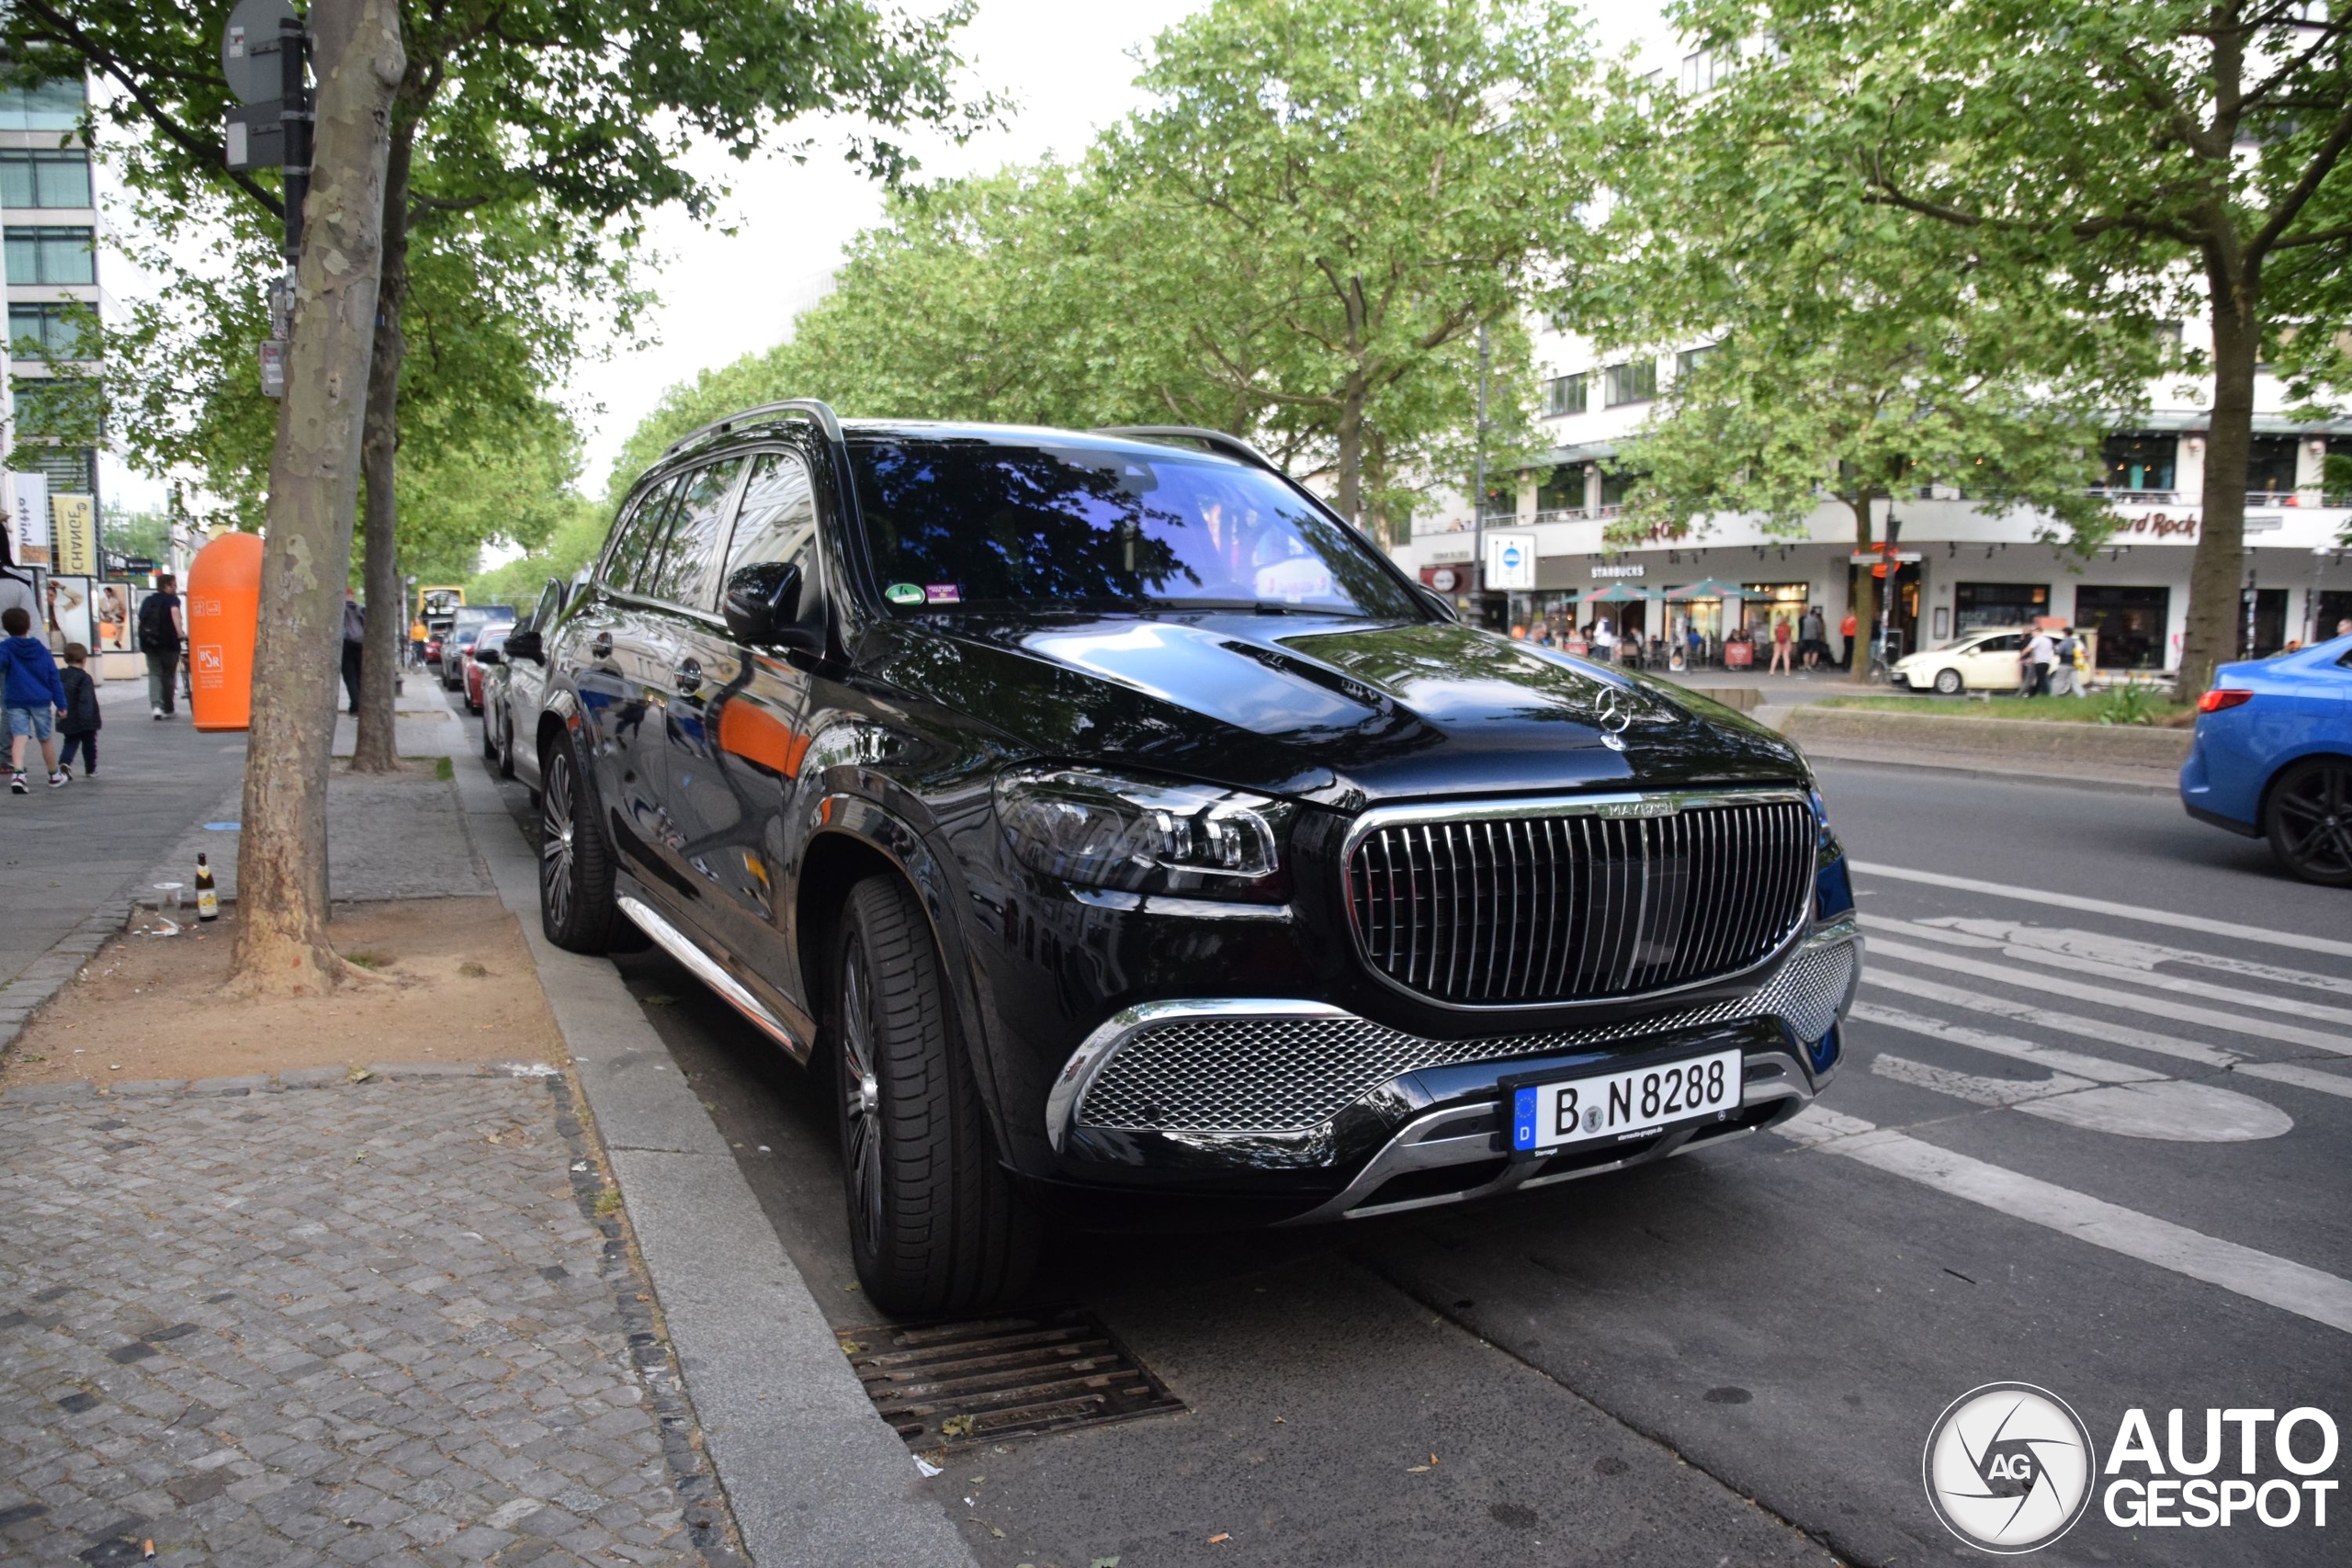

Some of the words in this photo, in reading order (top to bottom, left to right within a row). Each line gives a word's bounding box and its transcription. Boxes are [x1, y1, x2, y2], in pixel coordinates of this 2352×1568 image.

[2152, 513, 2197, 538] Rock
[1591, 564, 1645, 578] STARBUCKS
[199, 650, 220, 668] BSR
[1609, 801, 1674, 817] MAYBACH
[1555, 1088, 1579, 1136] B
[1608, 1077, 1632, 1127] N
[1641, 1059, 1724, 1119] 8288
[1520, 1126, 1530, 1141] D
